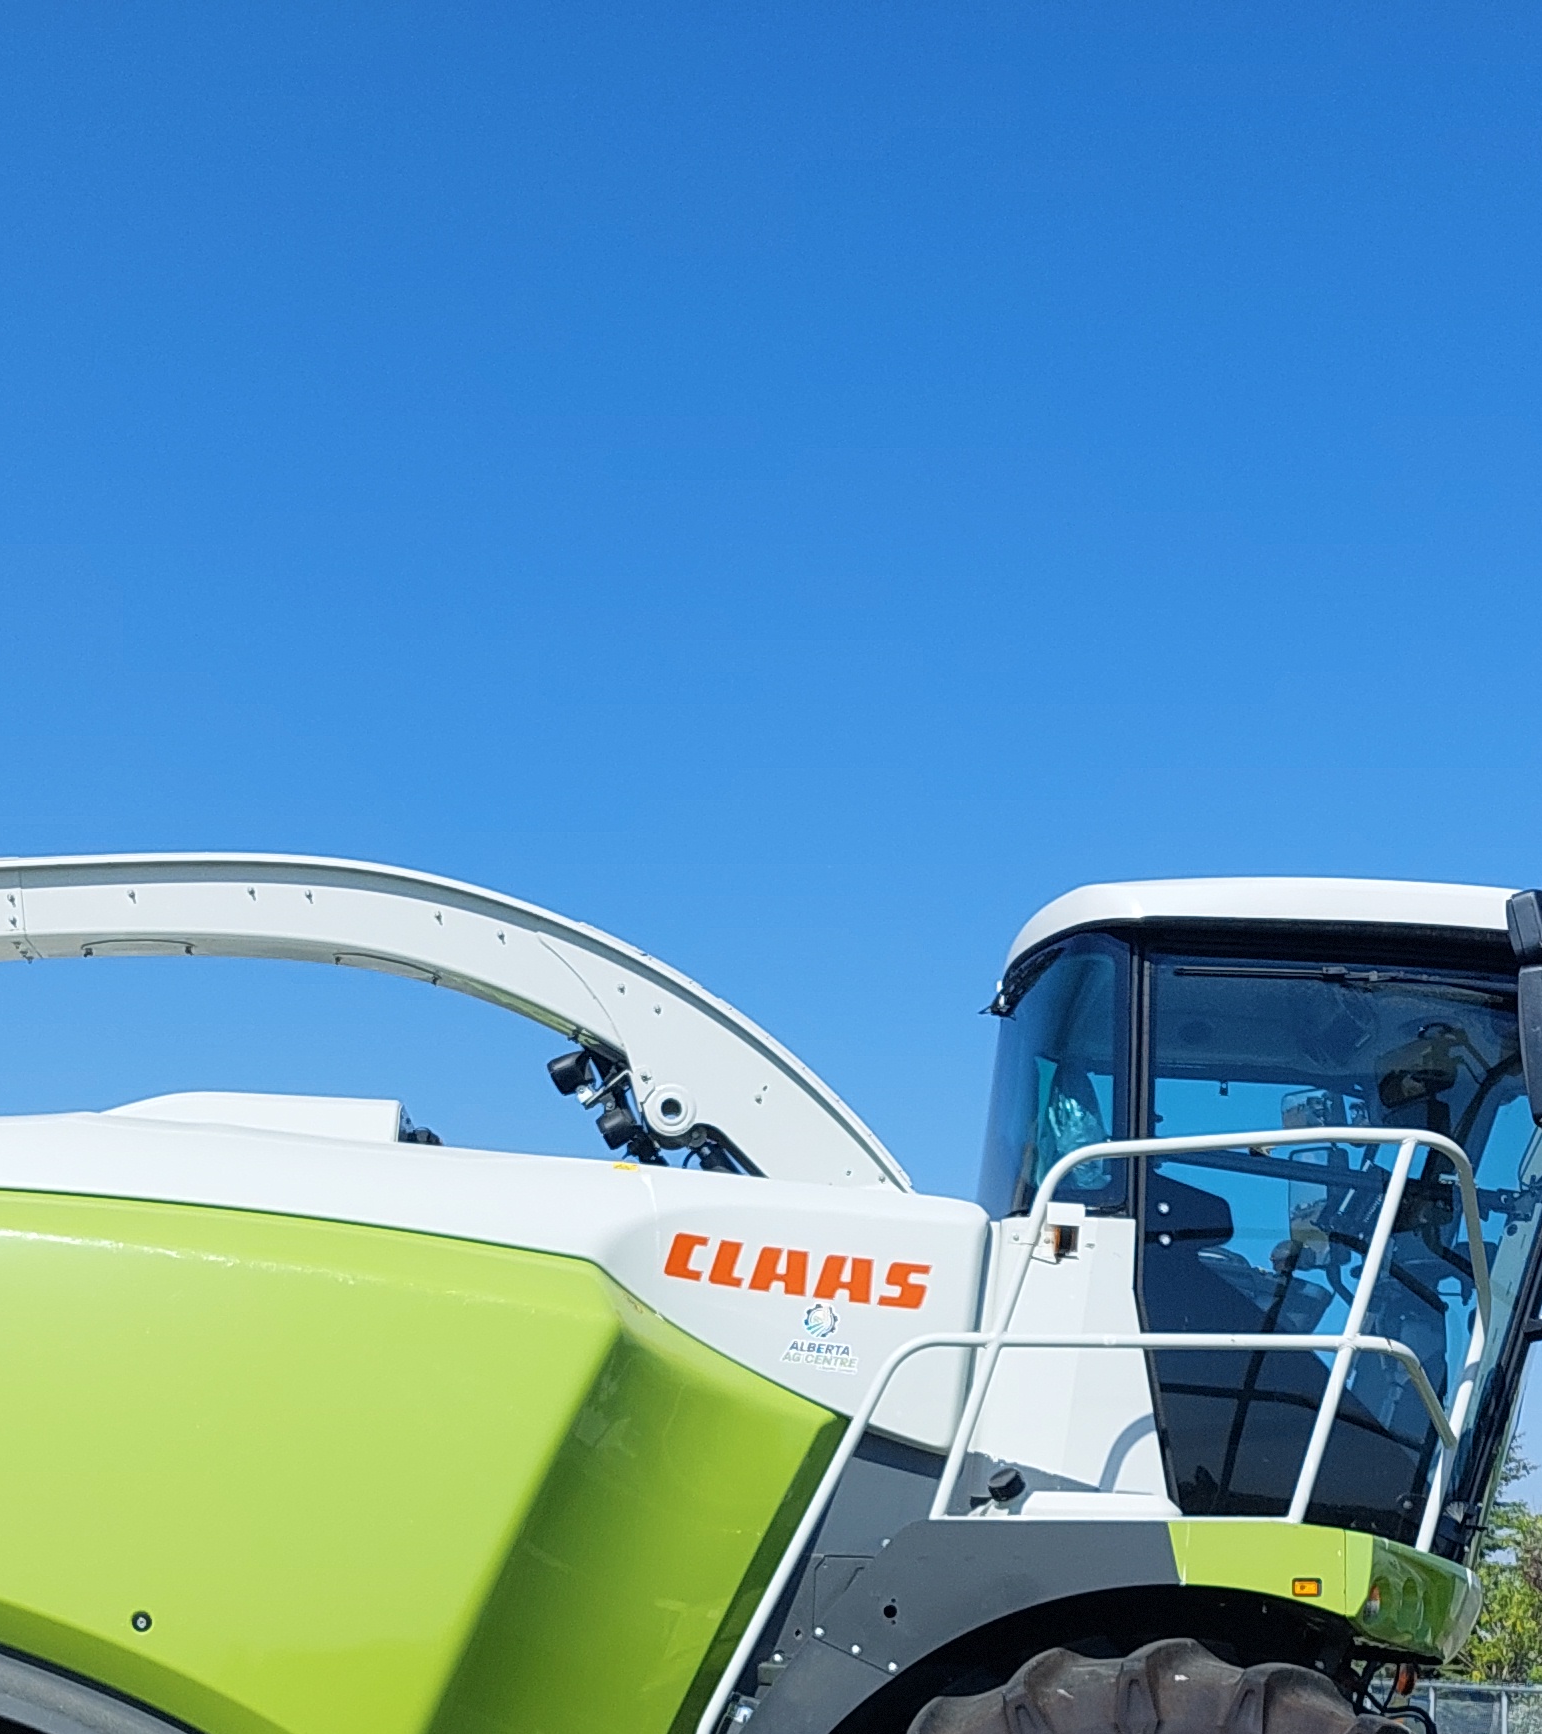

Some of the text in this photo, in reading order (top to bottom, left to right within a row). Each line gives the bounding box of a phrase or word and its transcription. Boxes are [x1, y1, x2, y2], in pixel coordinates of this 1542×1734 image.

[663, 1232, 933, 1310] CLAAS
[788, 1340, 850, 1357] ALBERTA
[781, 1351, 801, 1363] AG
[804, 1353, 858, 1369] CENTRE
